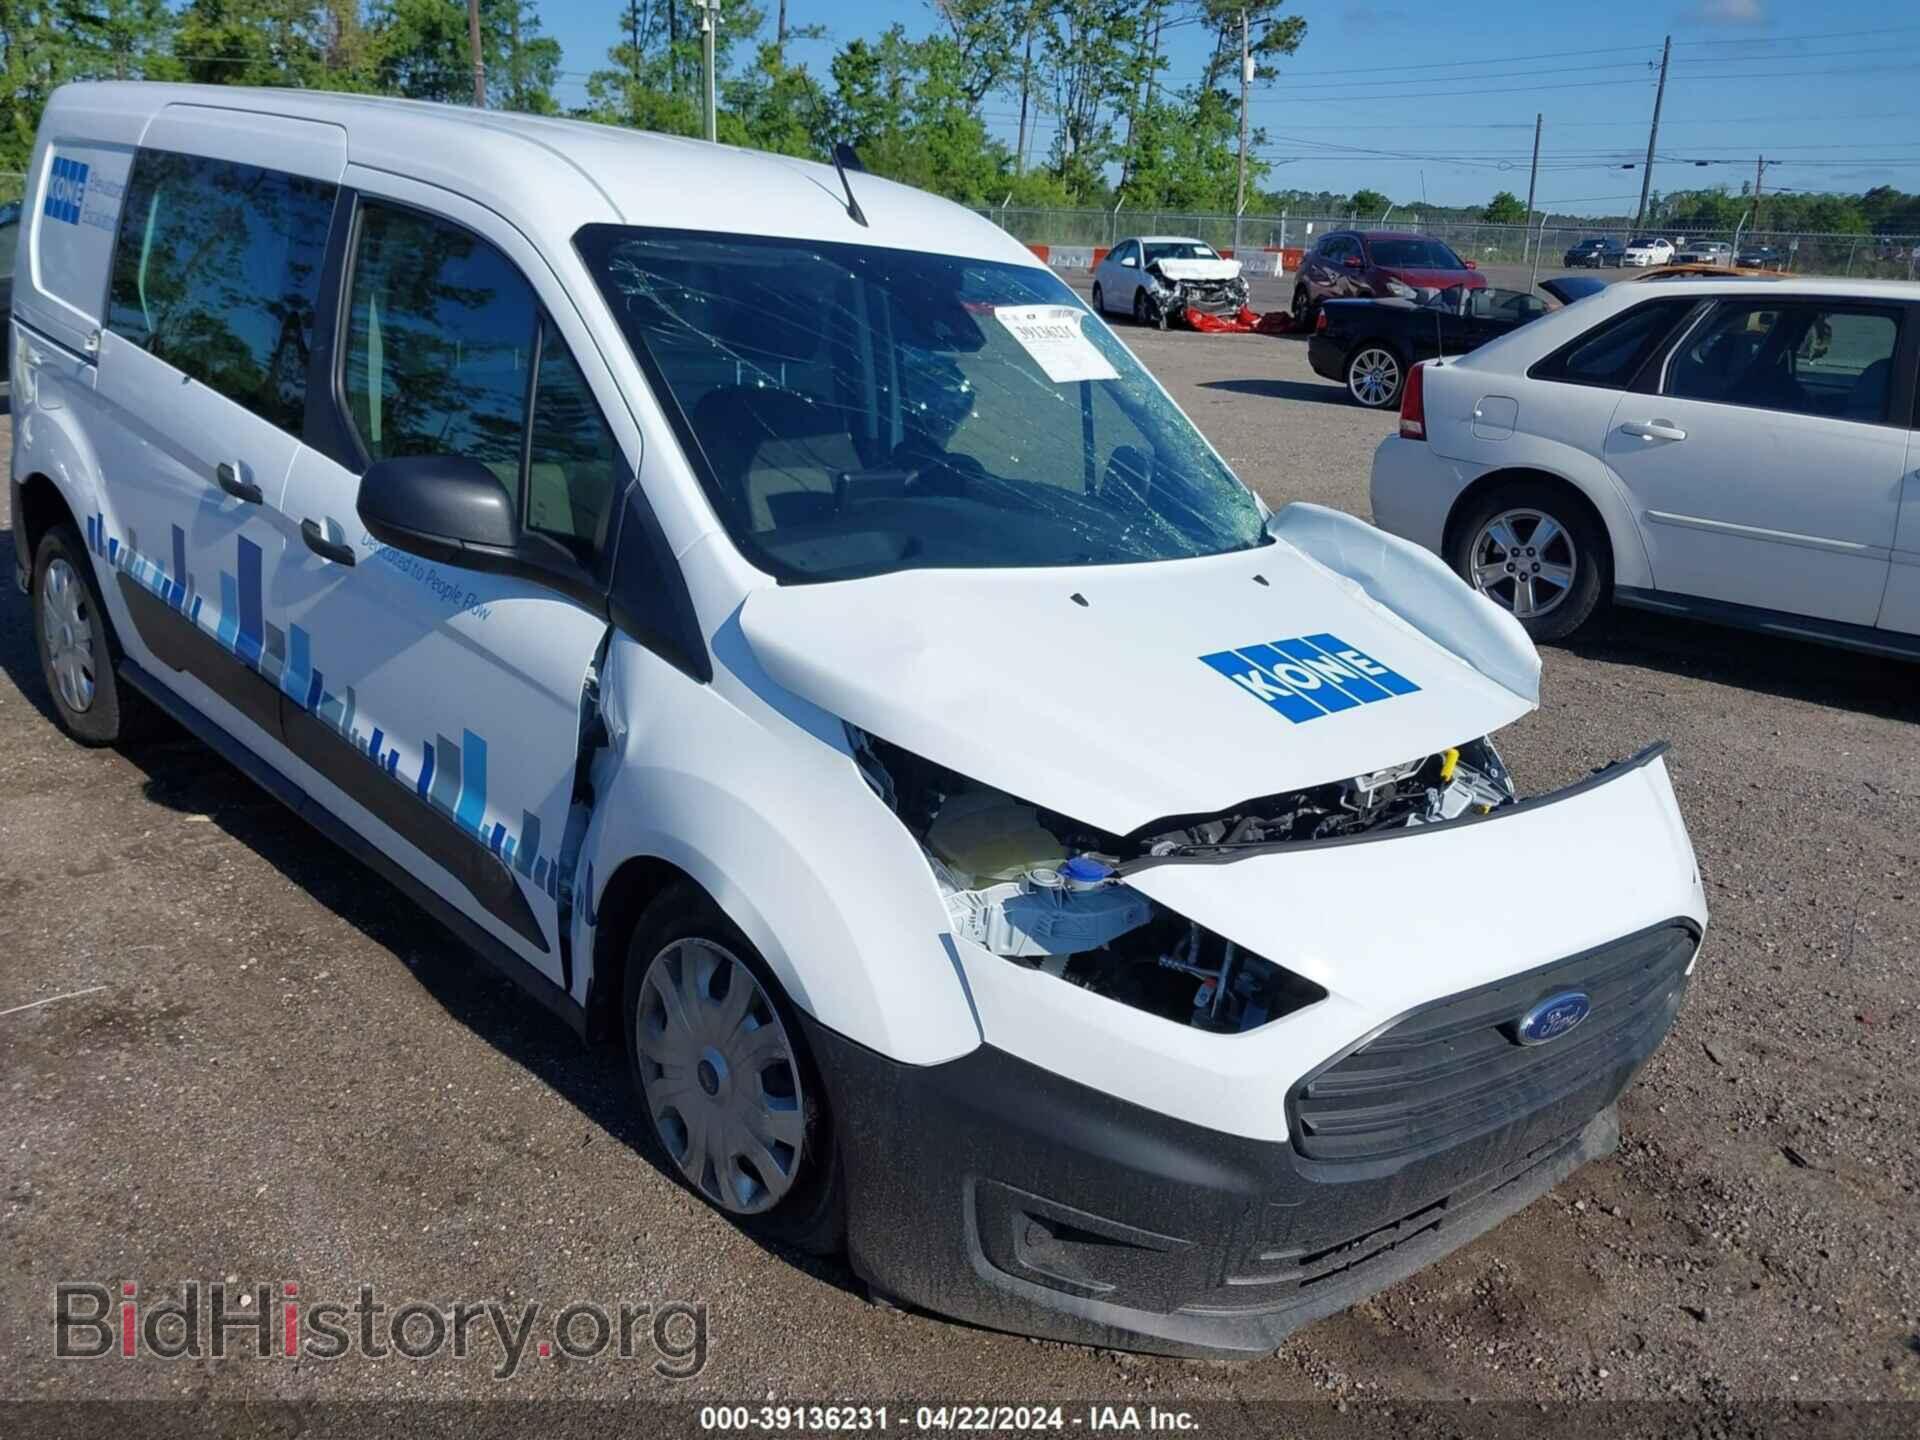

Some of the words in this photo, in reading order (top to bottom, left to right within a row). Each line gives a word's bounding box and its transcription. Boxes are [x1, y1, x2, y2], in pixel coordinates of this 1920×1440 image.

[410, 562, 425, 581] to
[425, 569, 461, 605] People
[462, 592, 492, 622] Flow
[1231, 649, 1388, 702] KONE
[1540, 1004, 1583, 1036] Ford
